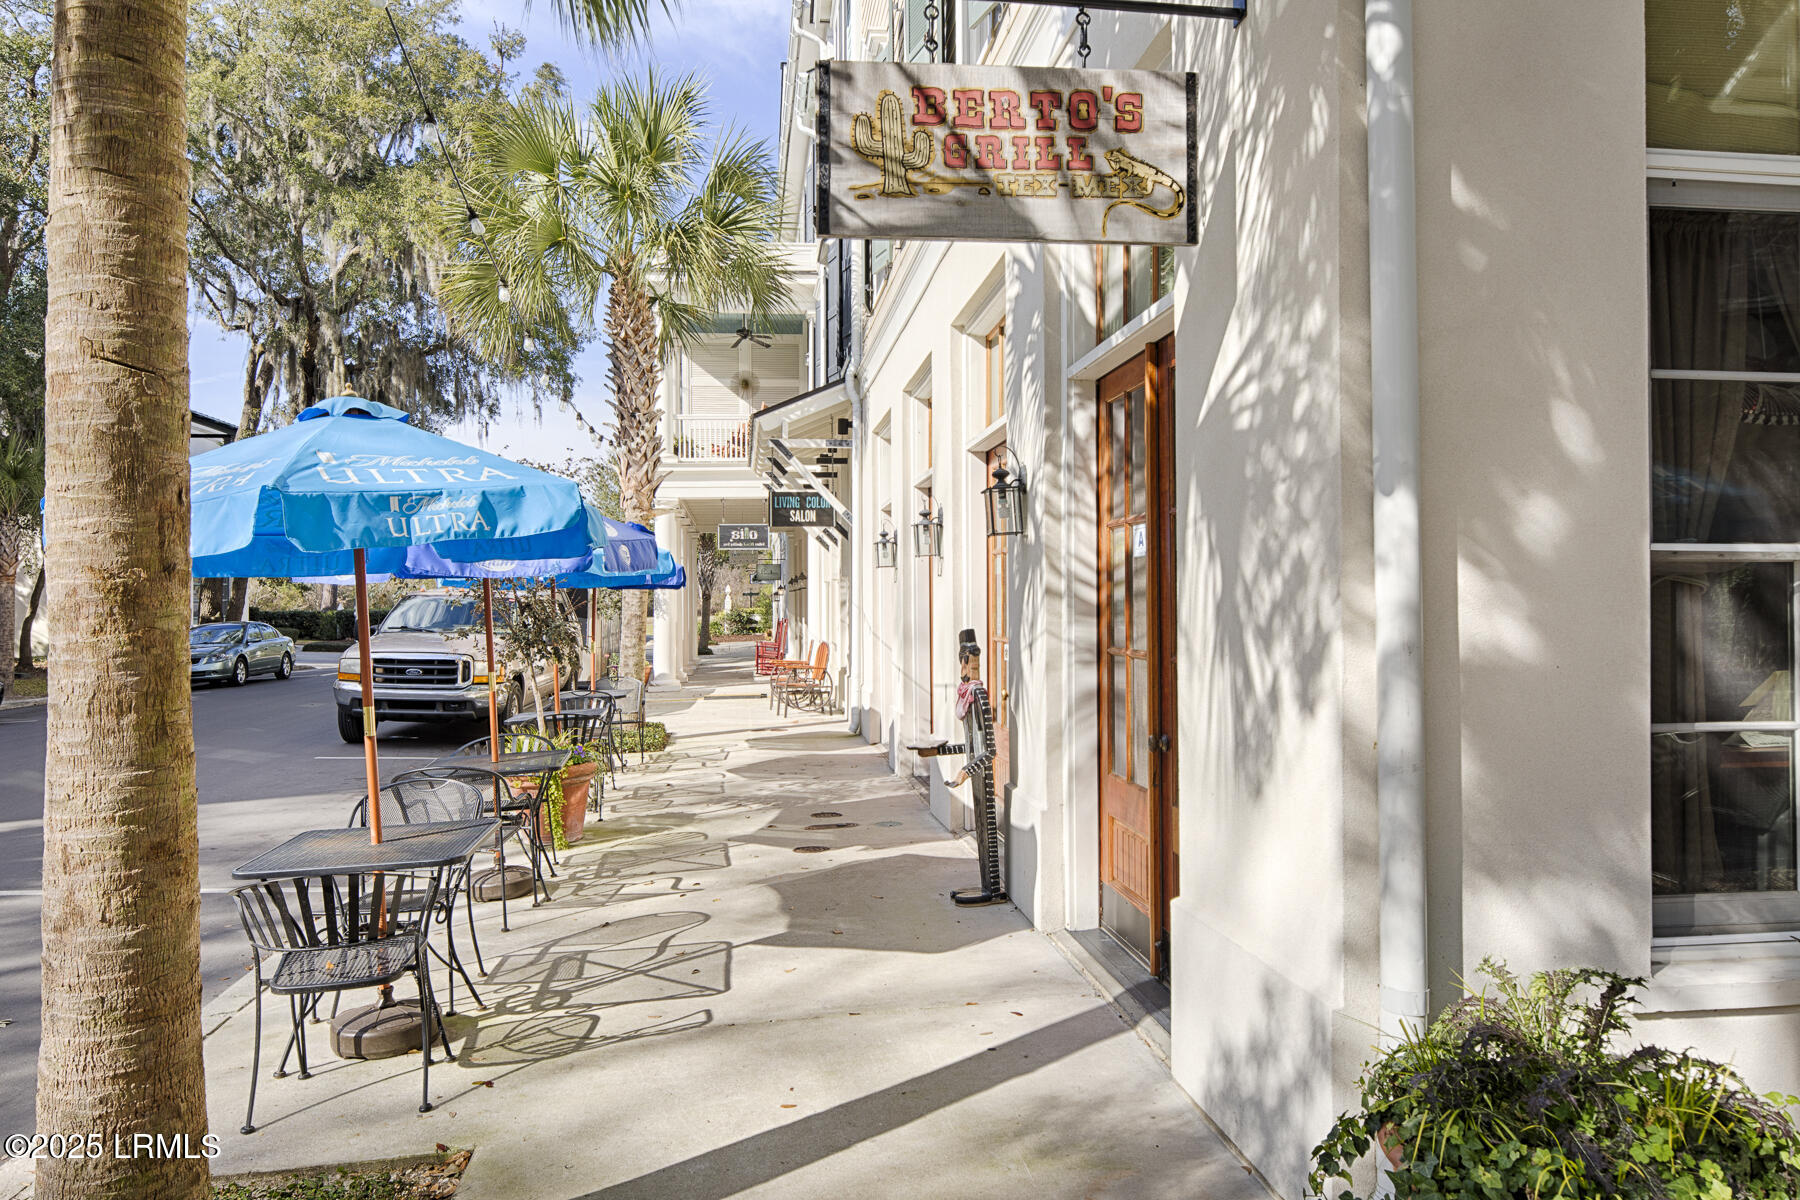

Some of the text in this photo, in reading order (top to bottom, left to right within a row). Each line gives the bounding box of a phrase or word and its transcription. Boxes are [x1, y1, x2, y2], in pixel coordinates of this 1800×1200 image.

[911, 86, 1144, 133] BERTO'S
[943, 134, 1094, 171] GRILL
[996, 174, 1146, 198] TEX-MEX
[316, 466, 519, 485] ULTRA
[774, 496, 800, 509] LIVING
[385, 510, 491, 538] ULTRA
[789, 510, 816, 523] SALON
[1138, 531, 1144, 547] A
